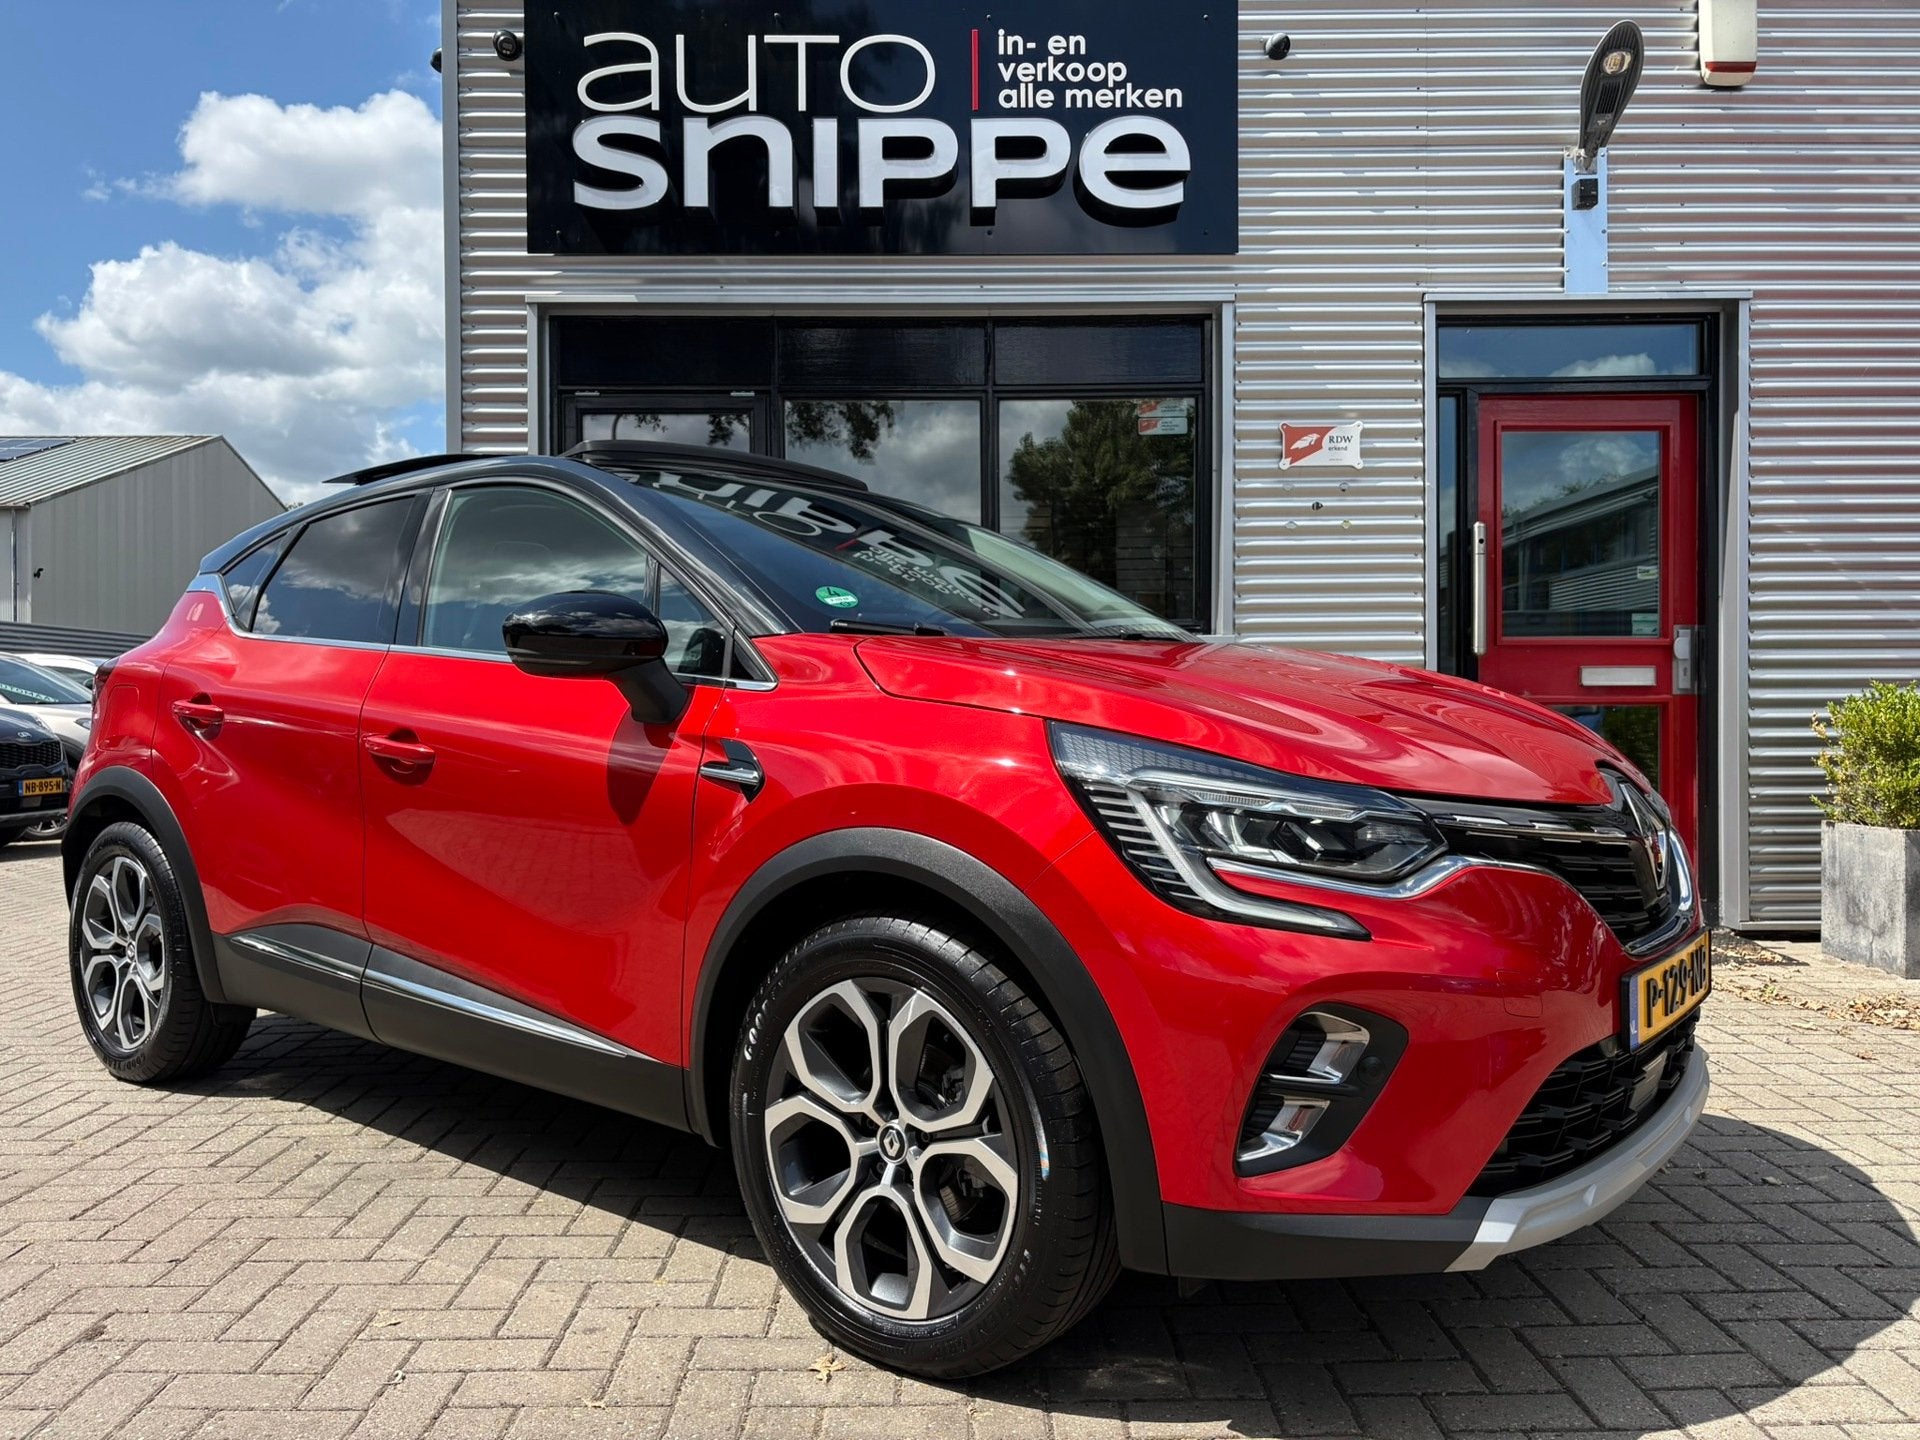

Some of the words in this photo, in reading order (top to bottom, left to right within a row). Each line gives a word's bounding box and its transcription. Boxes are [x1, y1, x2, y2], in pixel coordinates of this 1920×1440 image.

[998, 28, 1036, 55] in-
[1047, 34, 1086, 55] en
[997, 56, 1128, 88] verkoop
[998, 83, 1055, 109] alle
[1065, 82, 1183, 109] merken
[1328, 435, 1353, 444] RDW
[25, 780, 61, 794] NB-895-N
